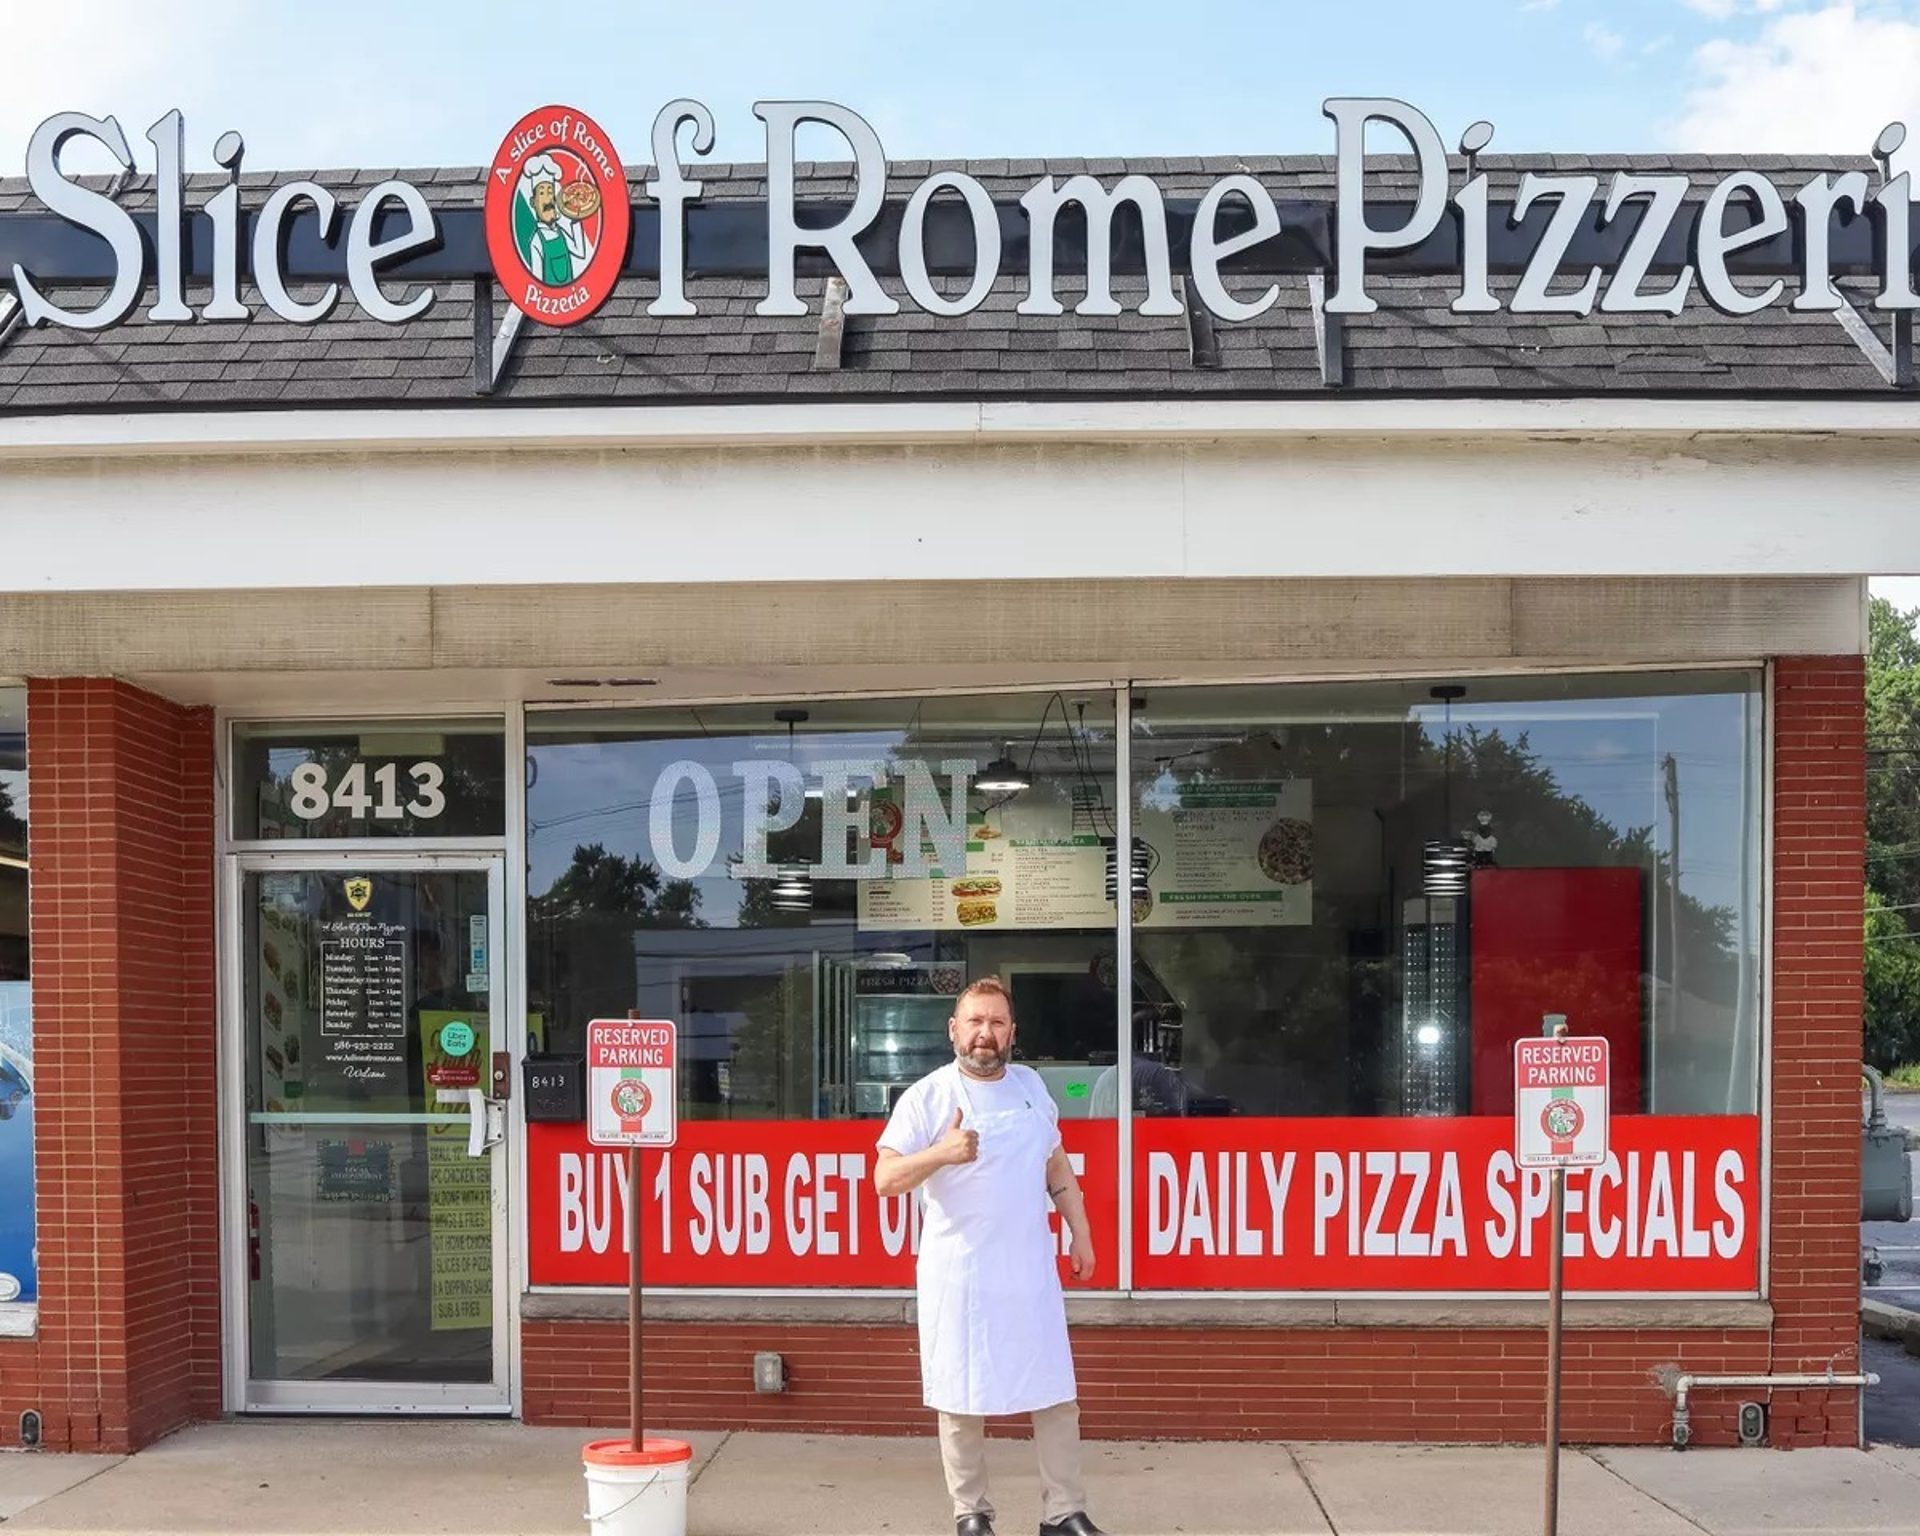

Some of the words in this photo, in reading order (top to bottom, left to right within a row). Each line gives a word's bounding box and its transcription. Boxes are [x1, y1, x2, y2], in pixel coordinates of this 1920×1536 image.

[495, 166, 513, 185] A
[510, 123, 547, 162] slice
[550, 115, 572, 143] of
[573, 121, 615, 182] Rome
[12, 108, 444, 328] Slice
[752, 100, 1283, 322] Rome
[524, 284, 591, 316] Pizzeria
[290, 762, 446, 820] 8413
[649, 759, 977, 880] OPEN
[340, 937, 385, 948] HOURS
[594, 1028, 670, 1045] RESERVED
[600, 1048, 663, 1065] PARKING
[1522, 1046, 1601, 1064] RESERVED
[532, 1075, 565, 1089] 8413
[1529, 1066, 1596, 1084] PARKING
[559, 1152, 631, 1254] BUY
[654, 1151, 672, 1254] 1
[689, 1151, 769, 1256] SUB
[784, 1151, 865, 1256] GET
[1148, 1151, 1296, 1256] DAILY
[1314, 1151, 1468, 1257] PIZZA
[1484, 1150, 1746, 1259] SPECIALS
